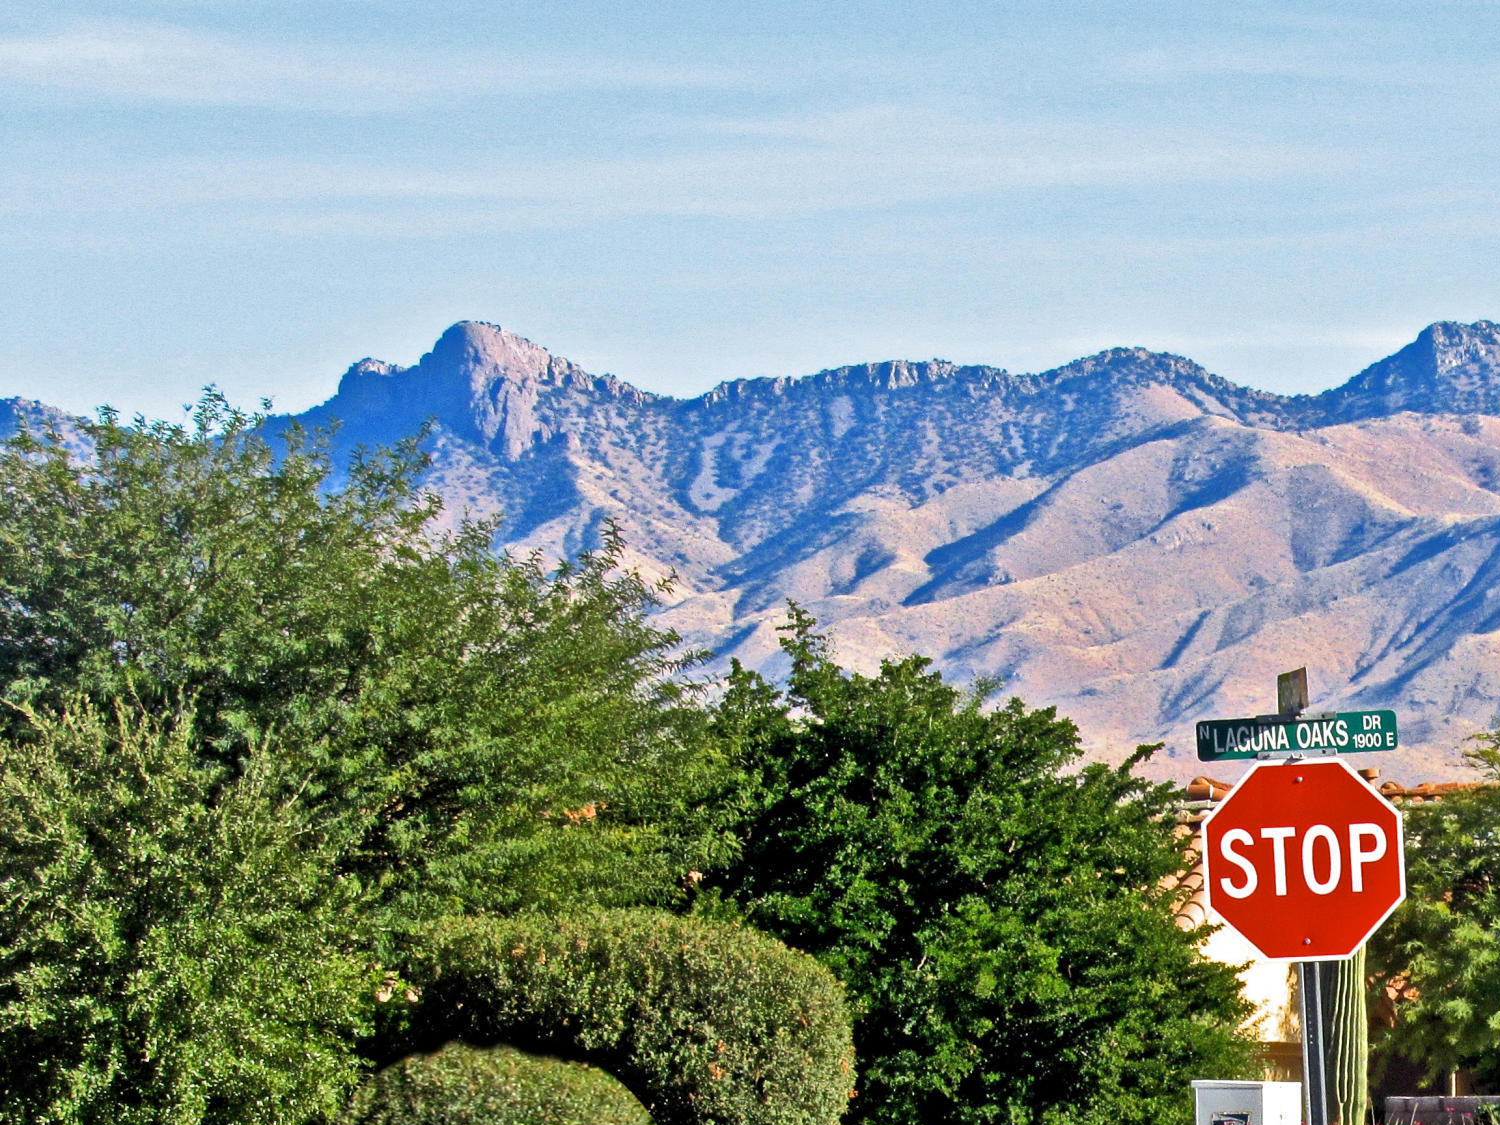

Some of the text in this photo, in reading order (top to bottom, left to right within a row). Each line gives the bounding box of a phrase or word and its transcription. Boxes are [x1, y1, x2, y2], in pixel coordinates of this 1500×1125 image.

[1199, 715, 1382, 753] N LAGUNA OAKS DR
[1352, 732, 1395, 749] 1900 E
[1219, 823, 1388, 900] STOP
